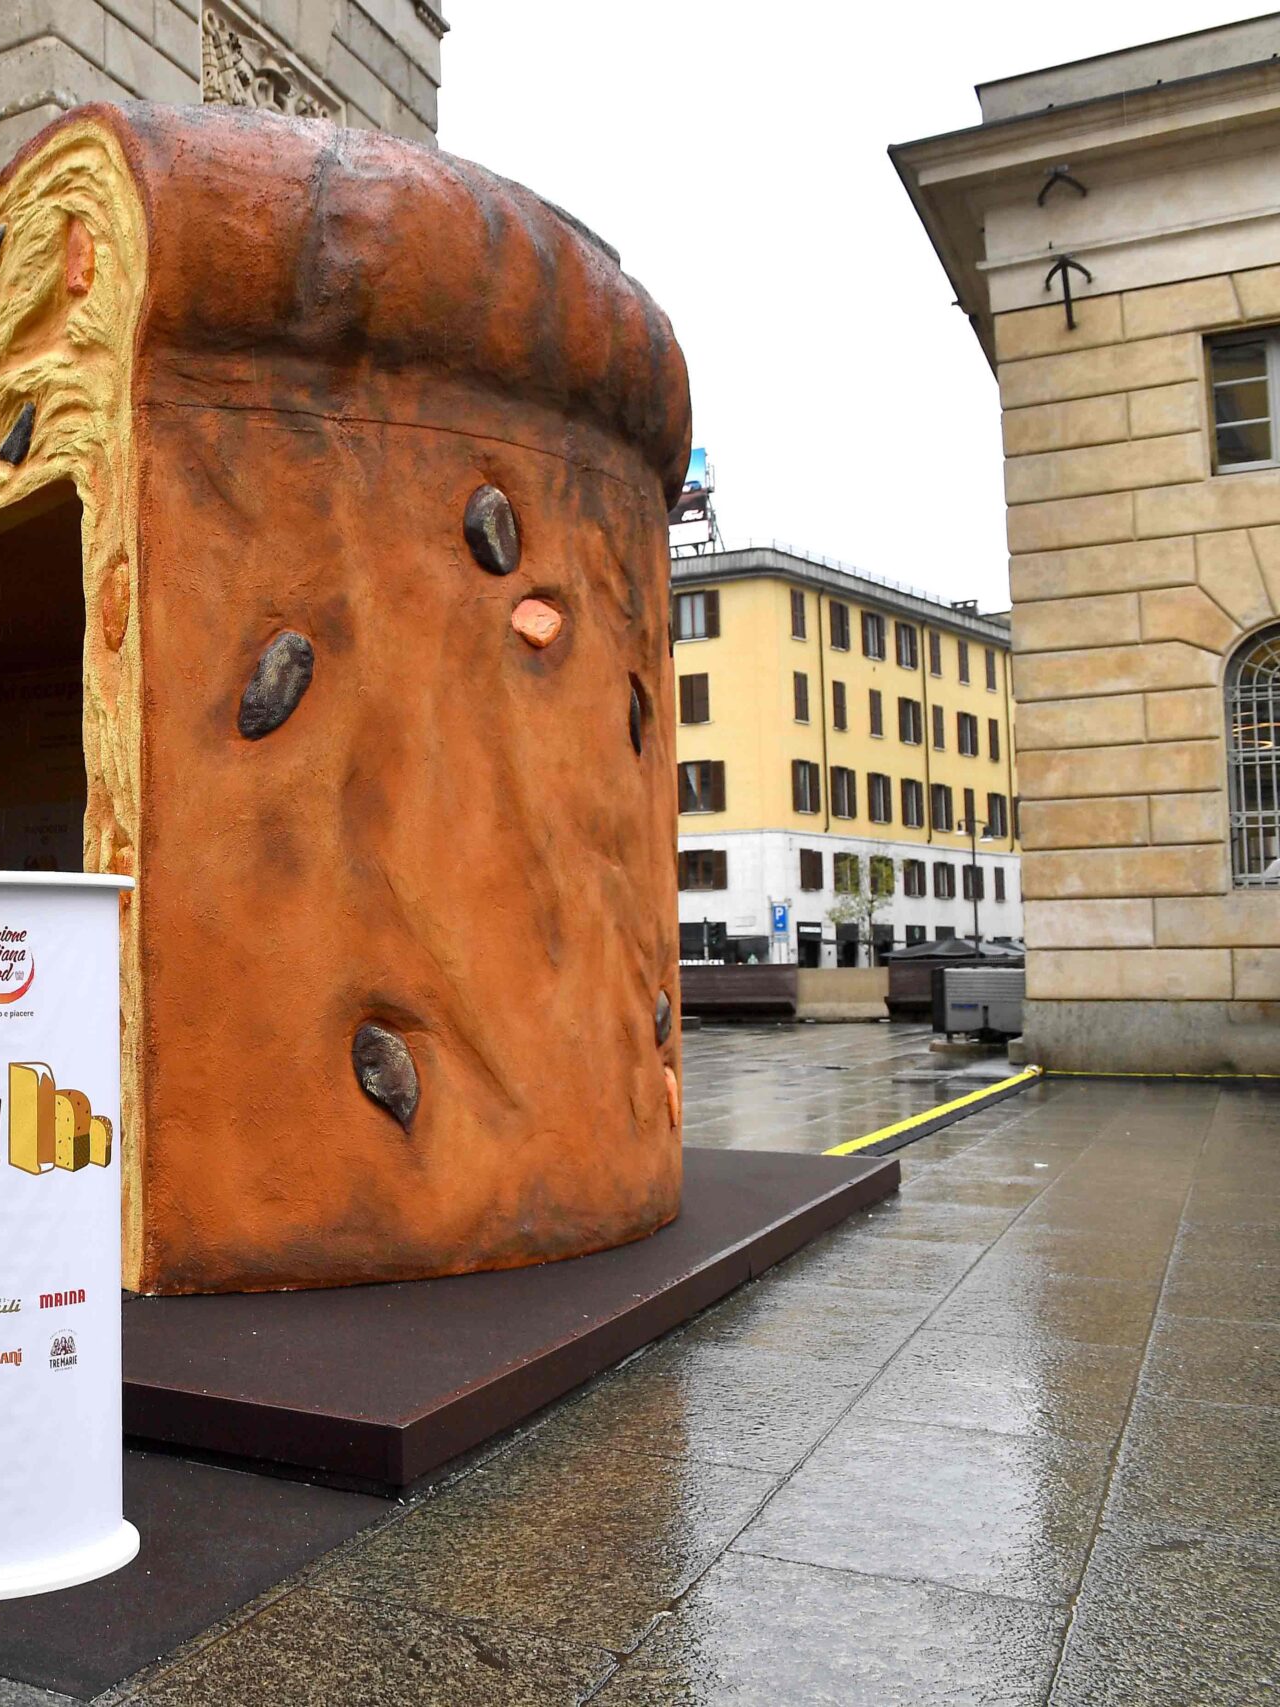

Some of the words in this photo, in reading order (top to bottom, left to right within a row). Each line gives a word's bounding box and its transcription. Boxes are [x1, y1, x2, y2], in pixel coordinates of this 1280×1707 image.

[775, 907, 784, 920] P
[9, 1010, 34, 1019] piacere
[39, 1289, 86, 1309] MAINA
[49, 1359, 60, 1369] TRE
[60, 1355, 78, 1367] MARIE
